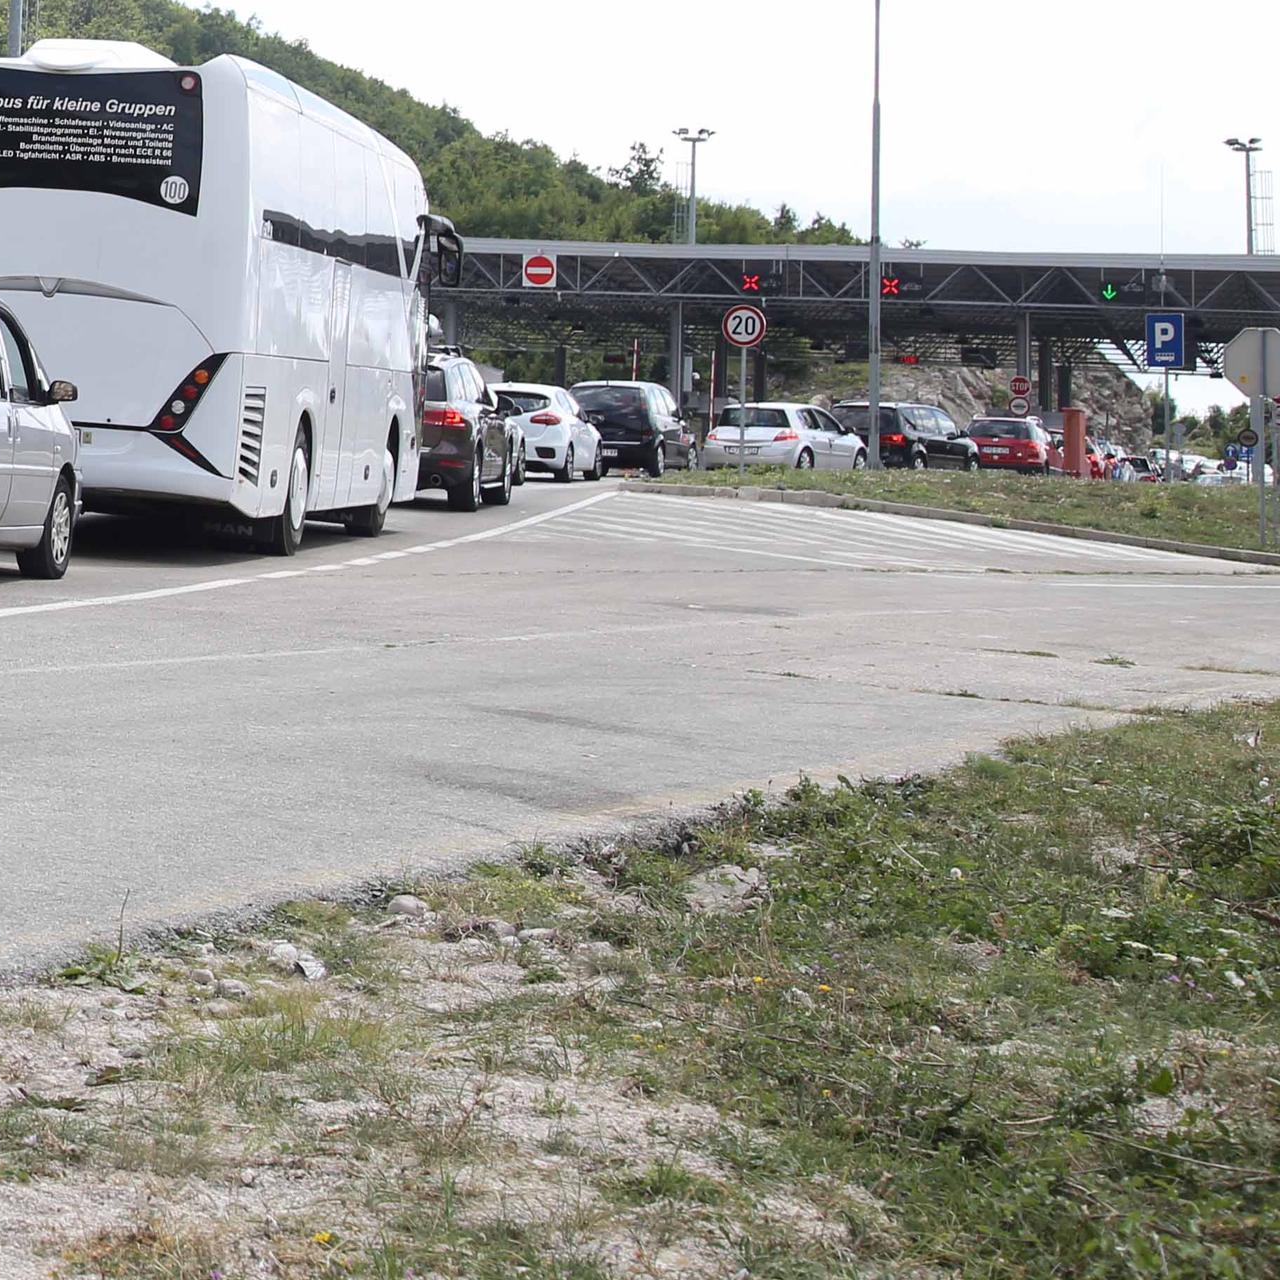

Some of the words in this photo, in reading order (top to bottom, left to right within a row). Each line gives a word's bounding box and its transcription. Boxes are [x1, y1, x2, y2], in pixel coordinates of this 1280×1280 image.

[27, 95, 50, 110] für
[53, 97, 101, 112] kleine
[105, 99, 176, 117] Gruppen
[54, 117, 102, 127] Schlafsessel
[109, 120, 156, 131] Videoanlage
[161, 123, 174, 131] AC
[7, 124, 83, 136] Stabilitätsprogramm
[103, 128, 174, 141] Niveauregulierung
[32, 133, 102, 145] Brandmeldeanlage
[104, 137, 126, 146] Motor
[128, 139, 143, 147] und
[145, 139, 173, 148] Toilette
[20, 142, 63, 151] Bordtoilette
[70, 143, 114, 154] Überrollfest
[116, 146, 135, 155] nach
[136, 148, 154, 156] ECE
[155, 148, 161, 156] R
[162, 149, 173, 157] 66
[16, 150, 59, 160] Tagfahrlicht
[65, 153, 82, 161] ASR
[89, 154, 106, 162] ABS
[112, 155, 172, 166] Bremsassistent
[163, 180, 186, 200] 100
[731, 315, 756, 336] 20
[1154, 322, 1175, 349] P
[1011, 382, 1029, 391] STOP
